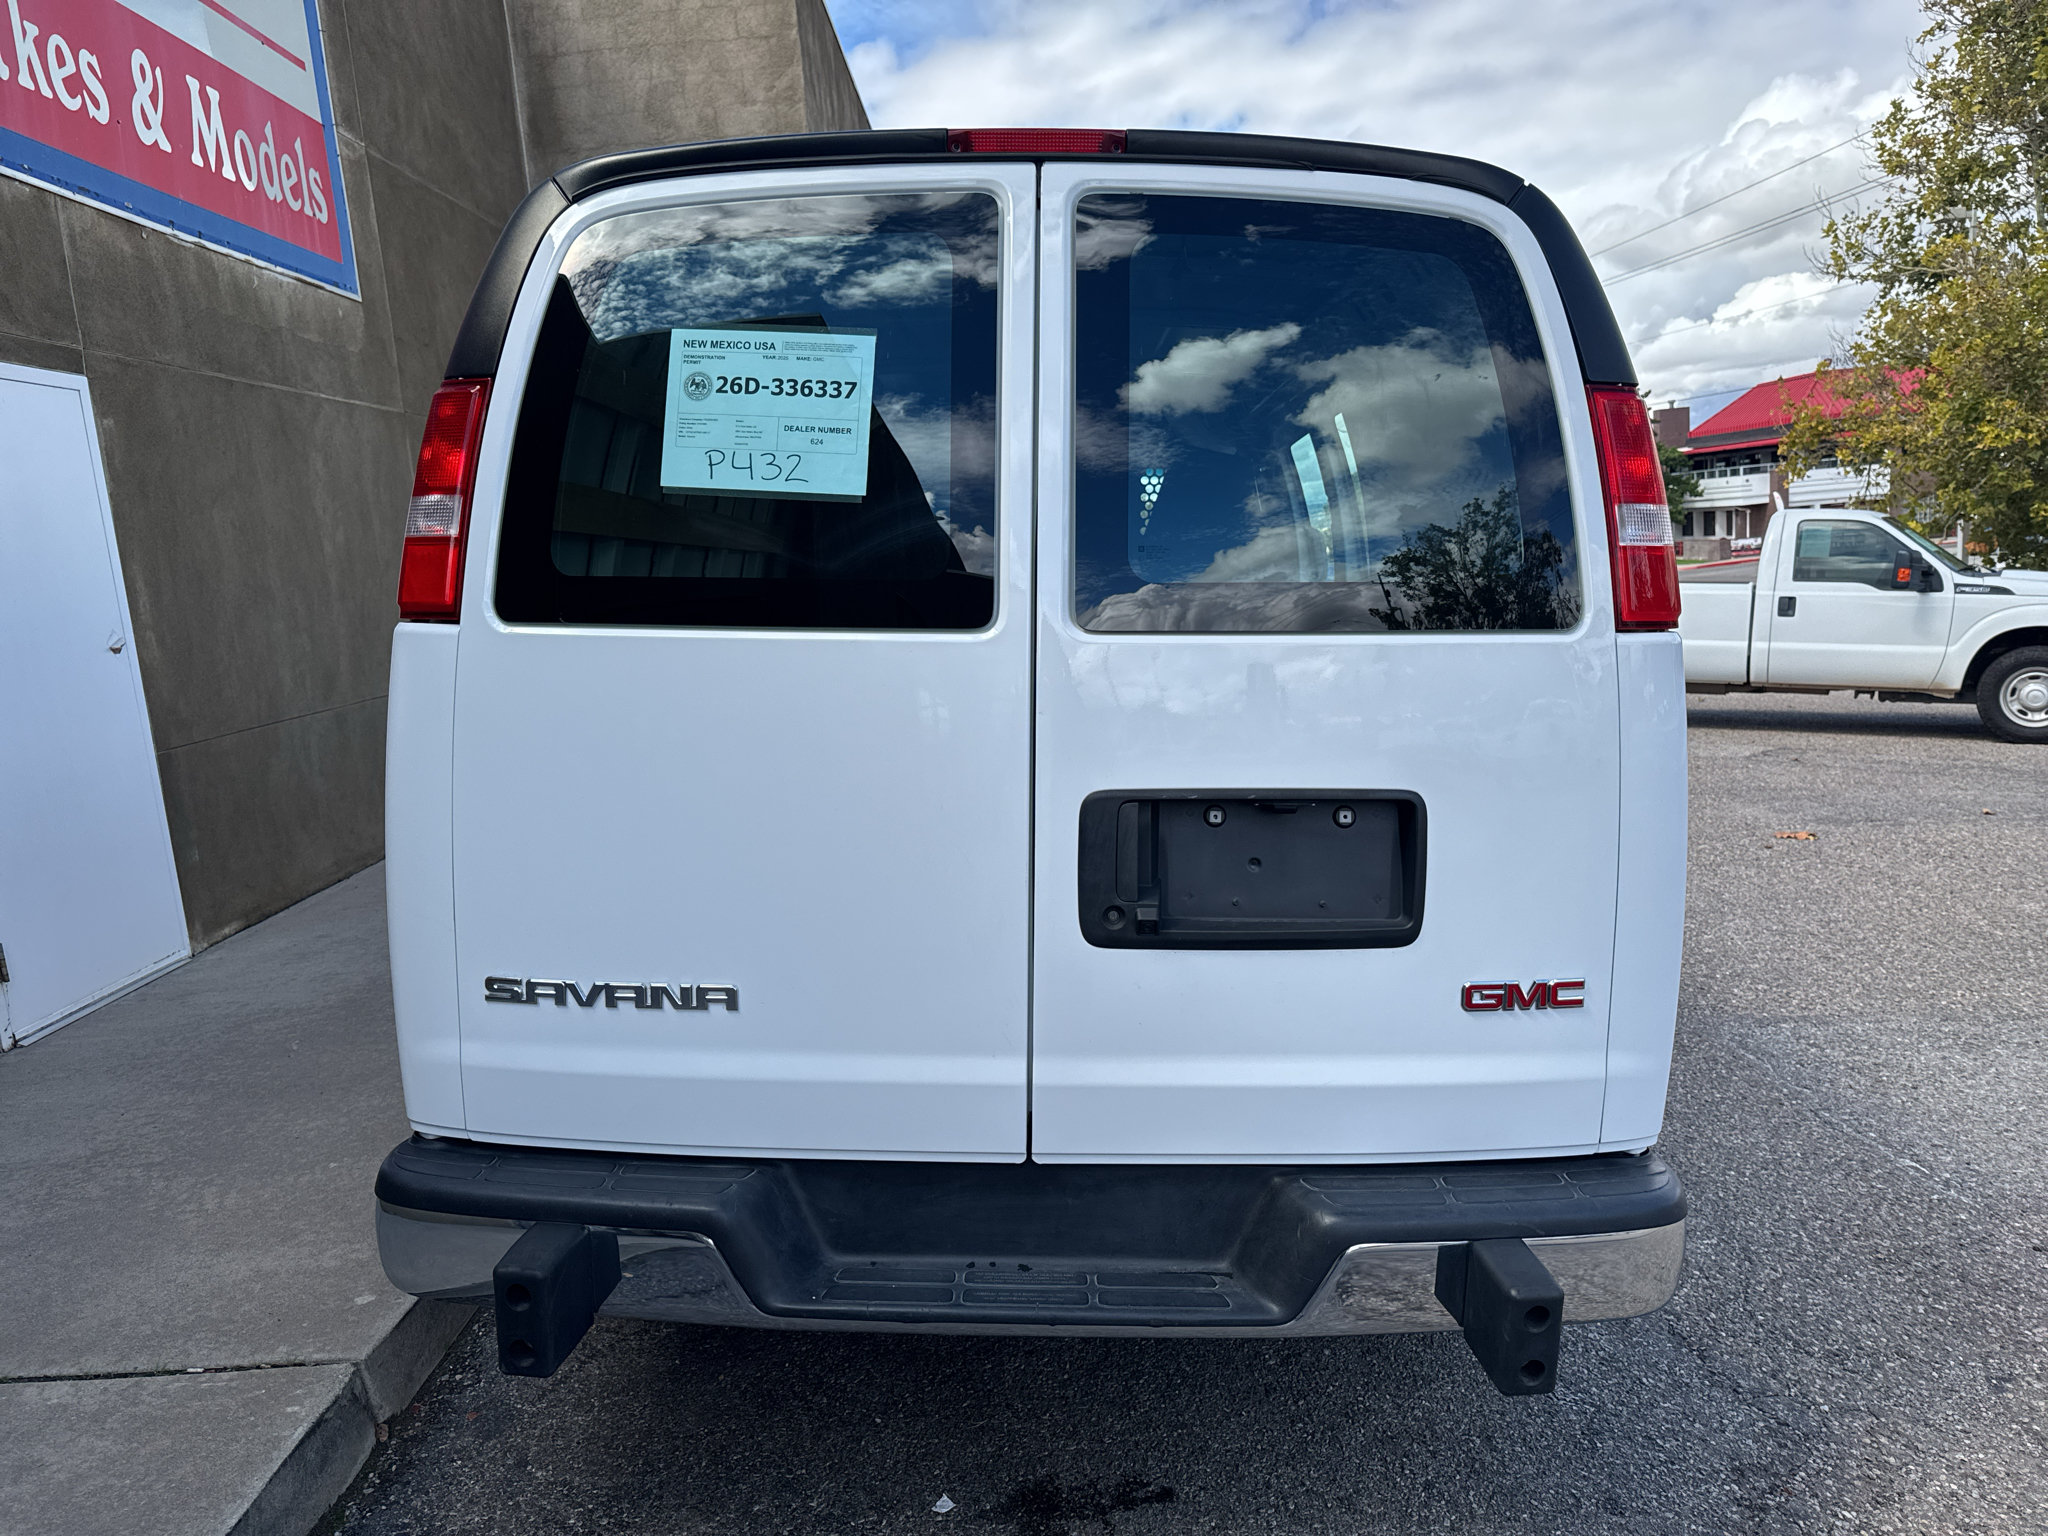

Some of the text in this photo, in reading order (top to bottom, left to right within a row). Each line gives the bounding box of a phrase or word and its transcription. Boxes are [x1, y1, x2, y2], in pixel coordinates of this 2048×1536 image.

[0, 0, 329, 225] kes & Models
[683, 339, 707, 350] NEW
[710, 340, 751, 351] MEXICO
[754, 341, 776, 351] USA
[715, 375, 858, 399] 26D-336337
[783, 425, 852, 435] DEALER NUMBER
[810, 438, 824, 446] 624
[704, 449, 809, 483] P432
[484, 975, 739, 1011] SAVANA
[1461, 977, 1586, 1014] GMC
